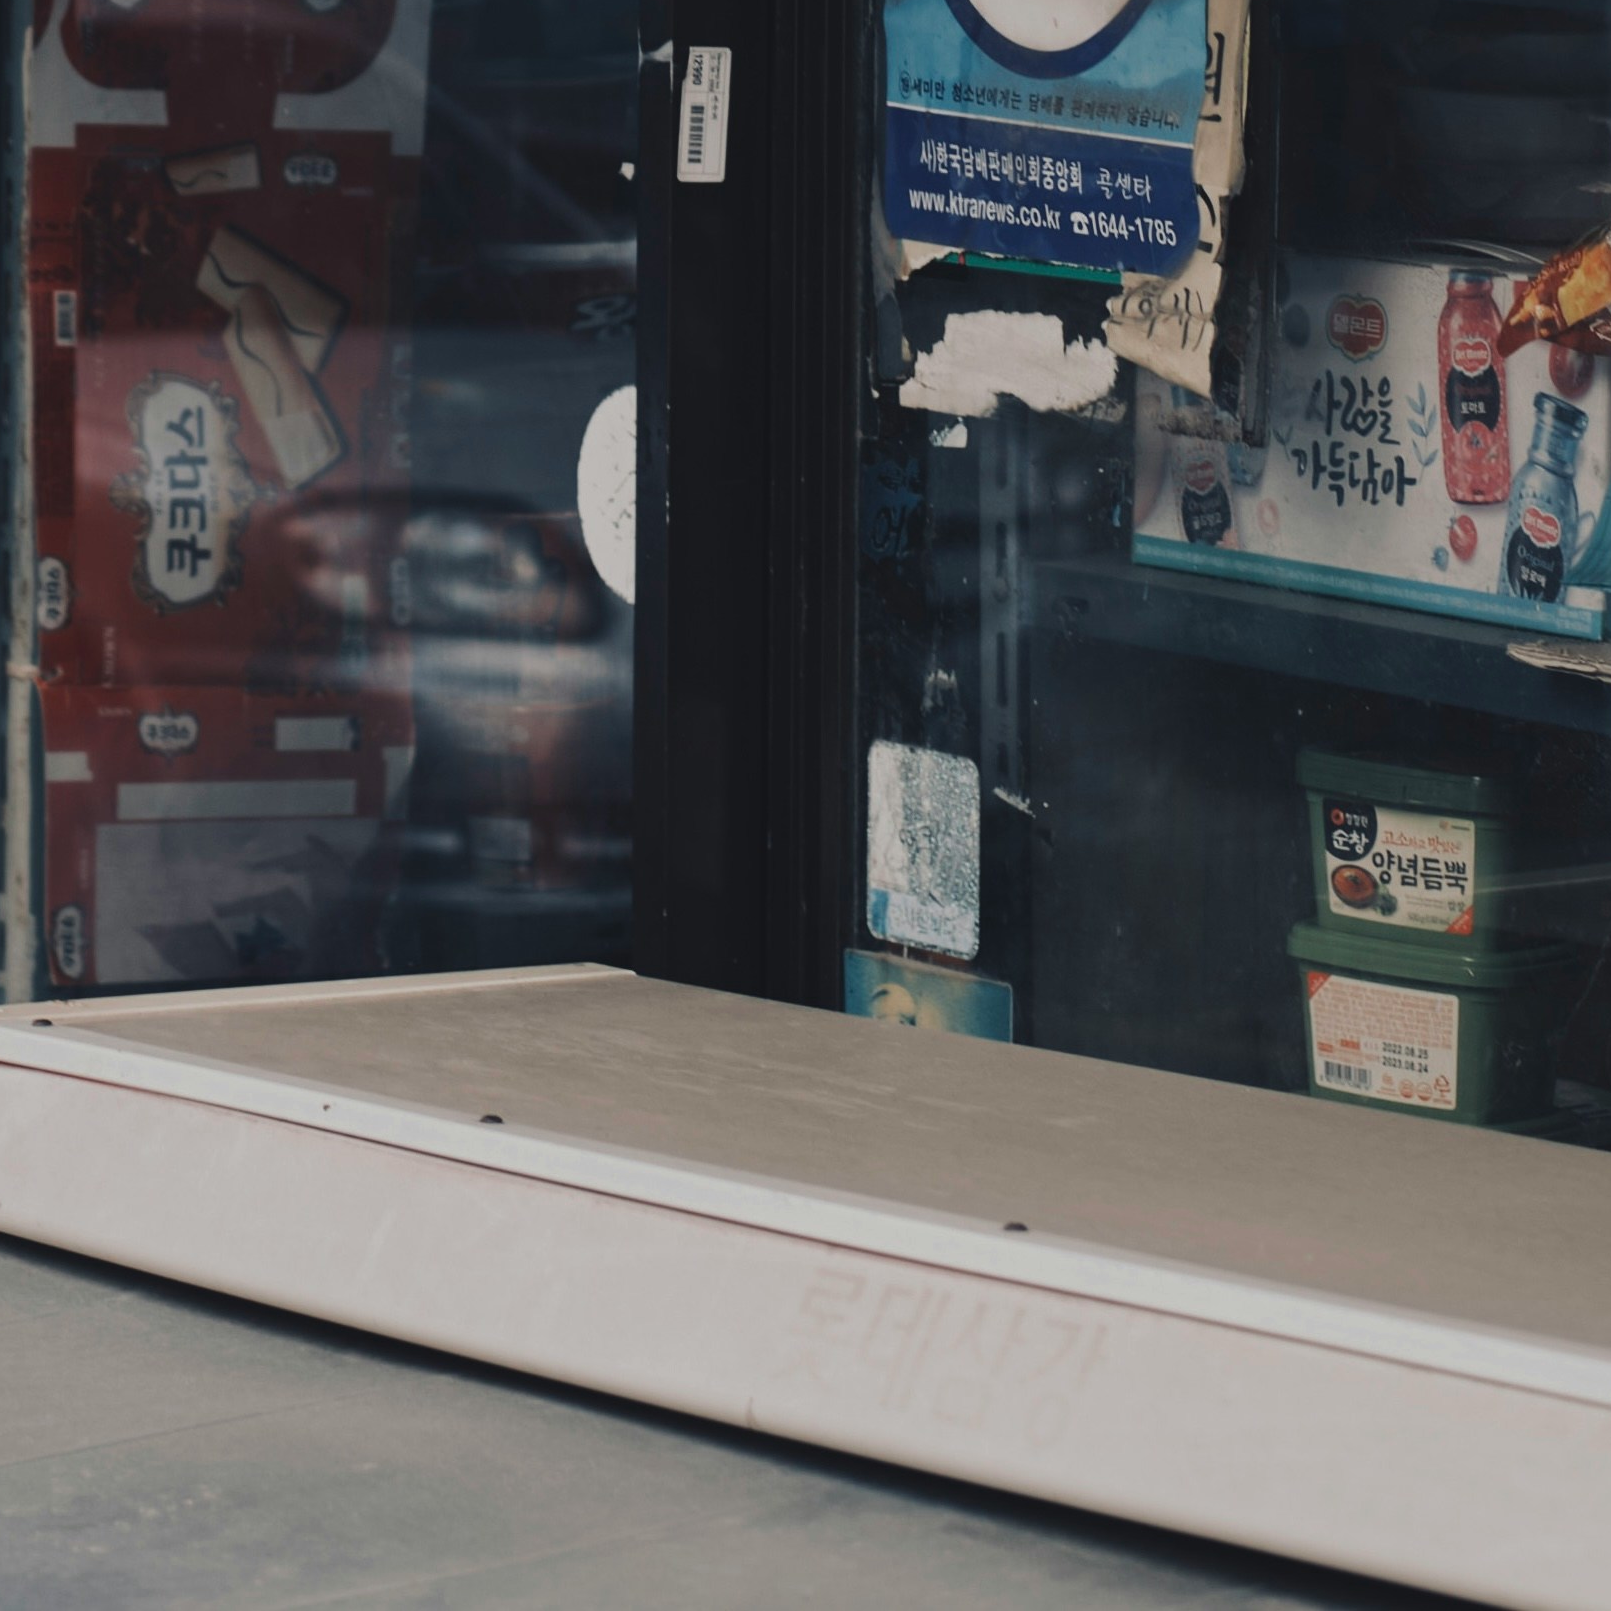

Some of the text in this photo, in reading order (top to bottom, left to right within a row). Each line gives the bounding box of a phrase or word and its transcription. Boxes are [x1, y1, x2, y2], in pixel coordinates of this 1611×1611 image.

[1096, 167, 1153, 205] 콜센타
[909, 185, 1177, 248] www.ktranews.co.kr 1644-1785
[1332, 313, 1382, 339] 델몬트
[1461, 401, 1487, 415] 토마토
[164, 406, 212, 578] 쿠크다스
[1291, 440, 1417, 507] 가득담아
[1332, 829, 1370, 855] 순창
[1372, 849, 1469, 896] 양념듬뿍
